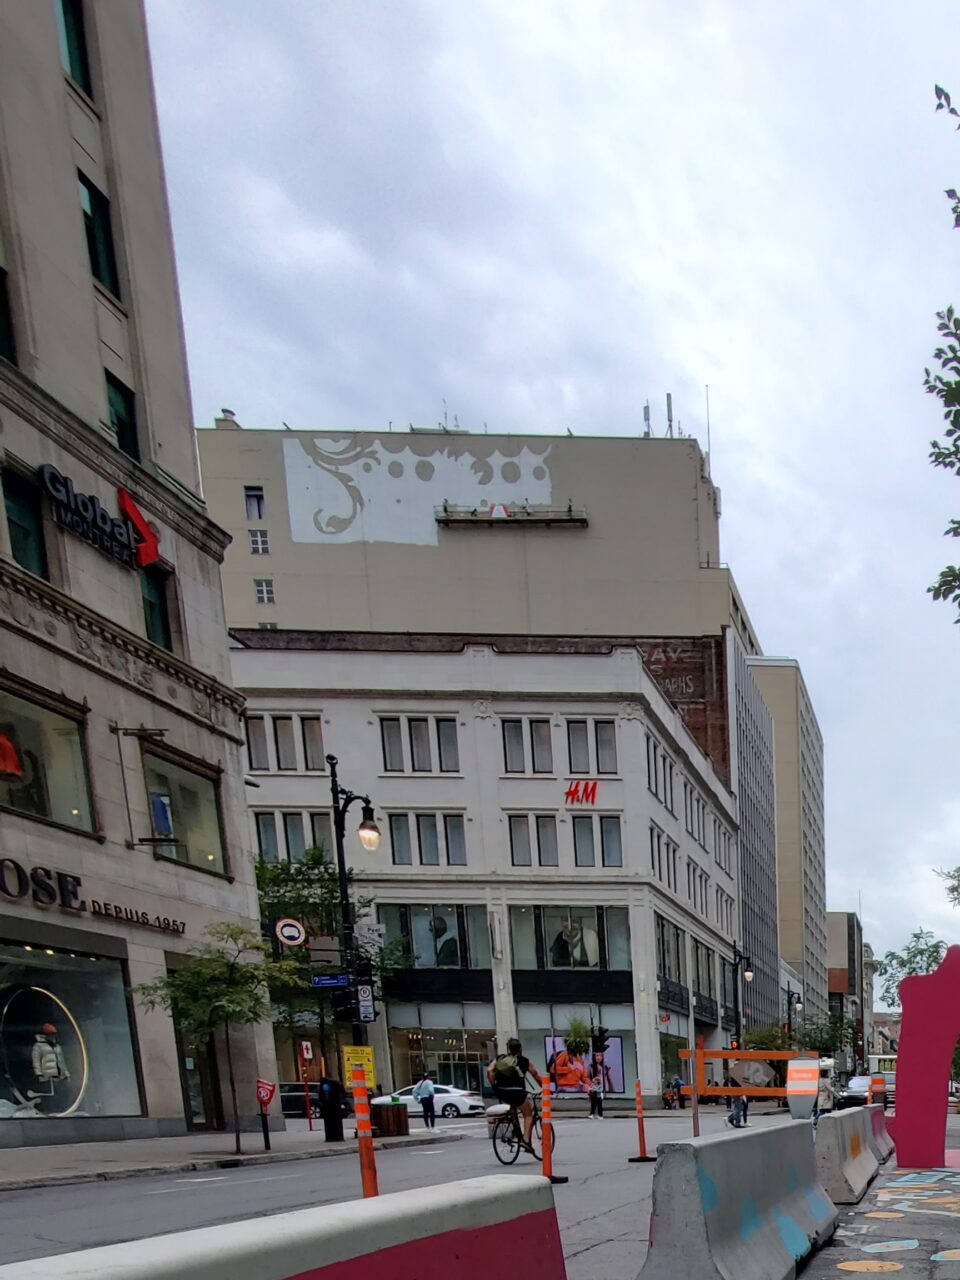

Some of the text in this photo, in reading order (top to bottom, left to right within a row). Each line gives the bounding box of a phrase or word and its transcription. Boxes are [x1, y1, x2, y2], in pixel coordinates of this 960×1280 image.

[41, 464, 136, 550] Global
[565, 780, 598, 805] H&M
[90, 900, 149, 924] DEPUIS
[155, 916, 186, 934] 1957
